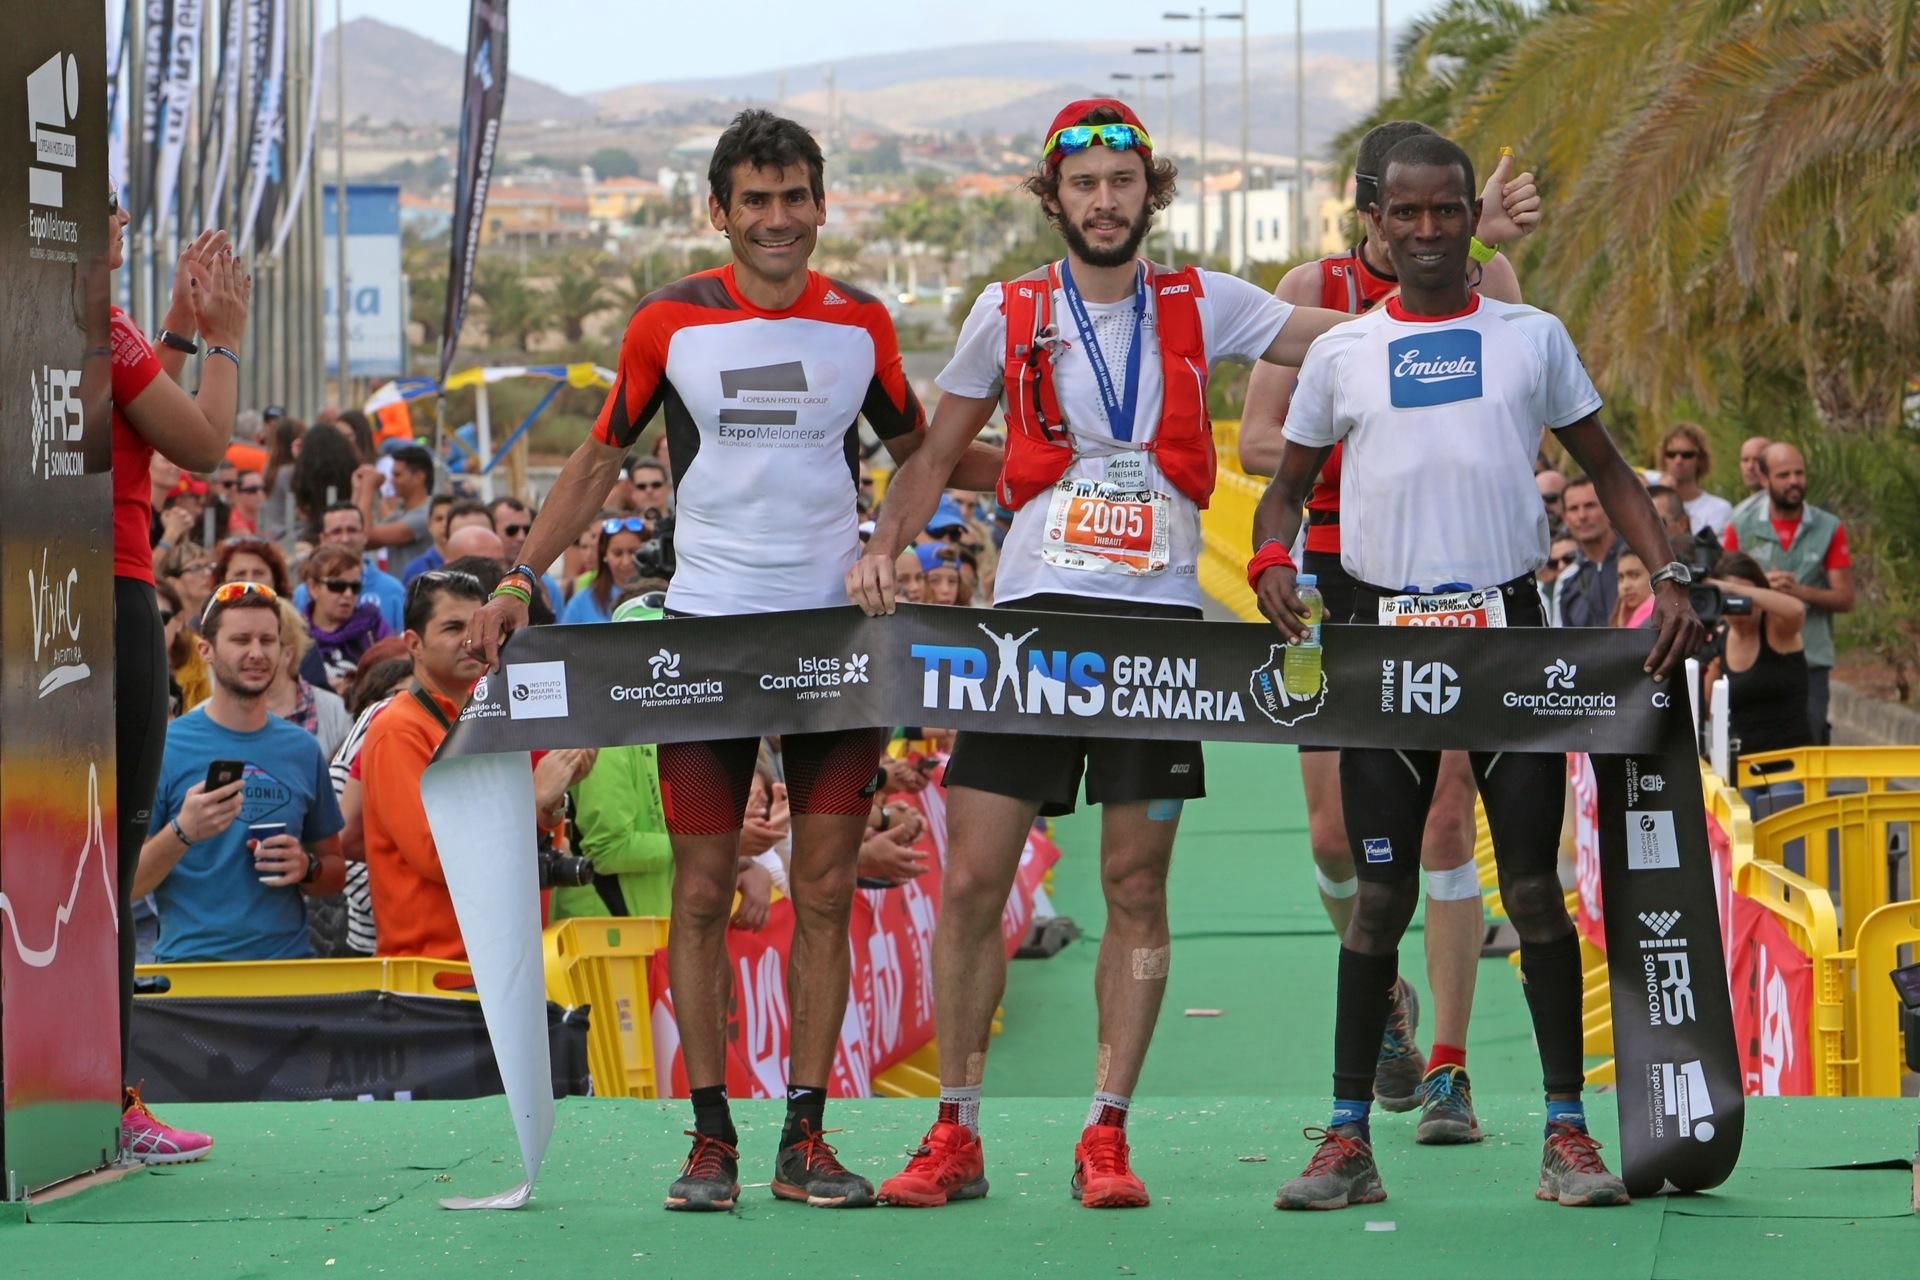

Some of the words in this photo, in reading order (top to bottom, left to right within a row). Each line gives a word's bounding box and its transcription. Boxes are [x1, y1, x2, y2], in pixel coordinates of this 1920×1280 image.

[29, 209, 78, 245] ExpoMeloneras
[1394, 349, 1477, 380] Emicela
[50, 369, 84, 441] RS
[742, 396, 777, 404] LOPESAN
[803, 397, 829, 405] GROUP
[719, 425, 826, 441] ExpoMeloneras
[718, 440, 751, 448] MELONERAS
[757, 441, 774, 449] GRAN
[804, 440, 824, 449] ESPAÑA
[51, 452, 84, 476] SONOCOM
[1108, 459, 1140, 469] Arista
[1107, 470, 1143, 479] FINISHER
[1076, 501, 1143, 538] 2005
[1093, 536, 1123, 547] THIBAUT
[1397, 595, 1439, 614] TRANS
[1438, 598, 1458, 606] GRAN
[53, 646, 82, 665] AVENTURA
[798, 656, 840, 673] Islas
[911, 622, 1106, 717] TRANS
[1112, 655, 1197, 688] GRAN
[610, 678, 722, 701] GranCanaria
[759, 671, 841, 690] Canarias
[1401, 660, 1461, 714] HG
[641, 697, 680, 707] Patronato
[682, 696, 692, 704] de
[692, 694, 724, 704] Turismo
[828, 690, 841, 698] VIDA
[1503, 691, 1616, 708] GranCanaria
[462, 702, 490, 715] Cabildo
[491, 702, 501, 710] de
[1111, 687, 1246, 722] CANARIA
[1533, 707, 1572, 716] Patronato
[1574, 708, 1583, 716] de
[1585, 708, 1616, 716] Turismo
[459, 711, 477, 721] Gran
[478, 709, 507, 718] Canaria
[1631, 761, 1639, 792] Cabildo
[1633, 793, 1640, 802] de
[1640, 833, 1648, 864] DEPORTES
[1652, 833, 1660, 864] INSTITUTO
[1643, 954, 1661, 1026] SONOCOM
[1657, 952, 1696, 1025] RS
[1651, 1063, 1664, 1138] ExpoMeloneras
